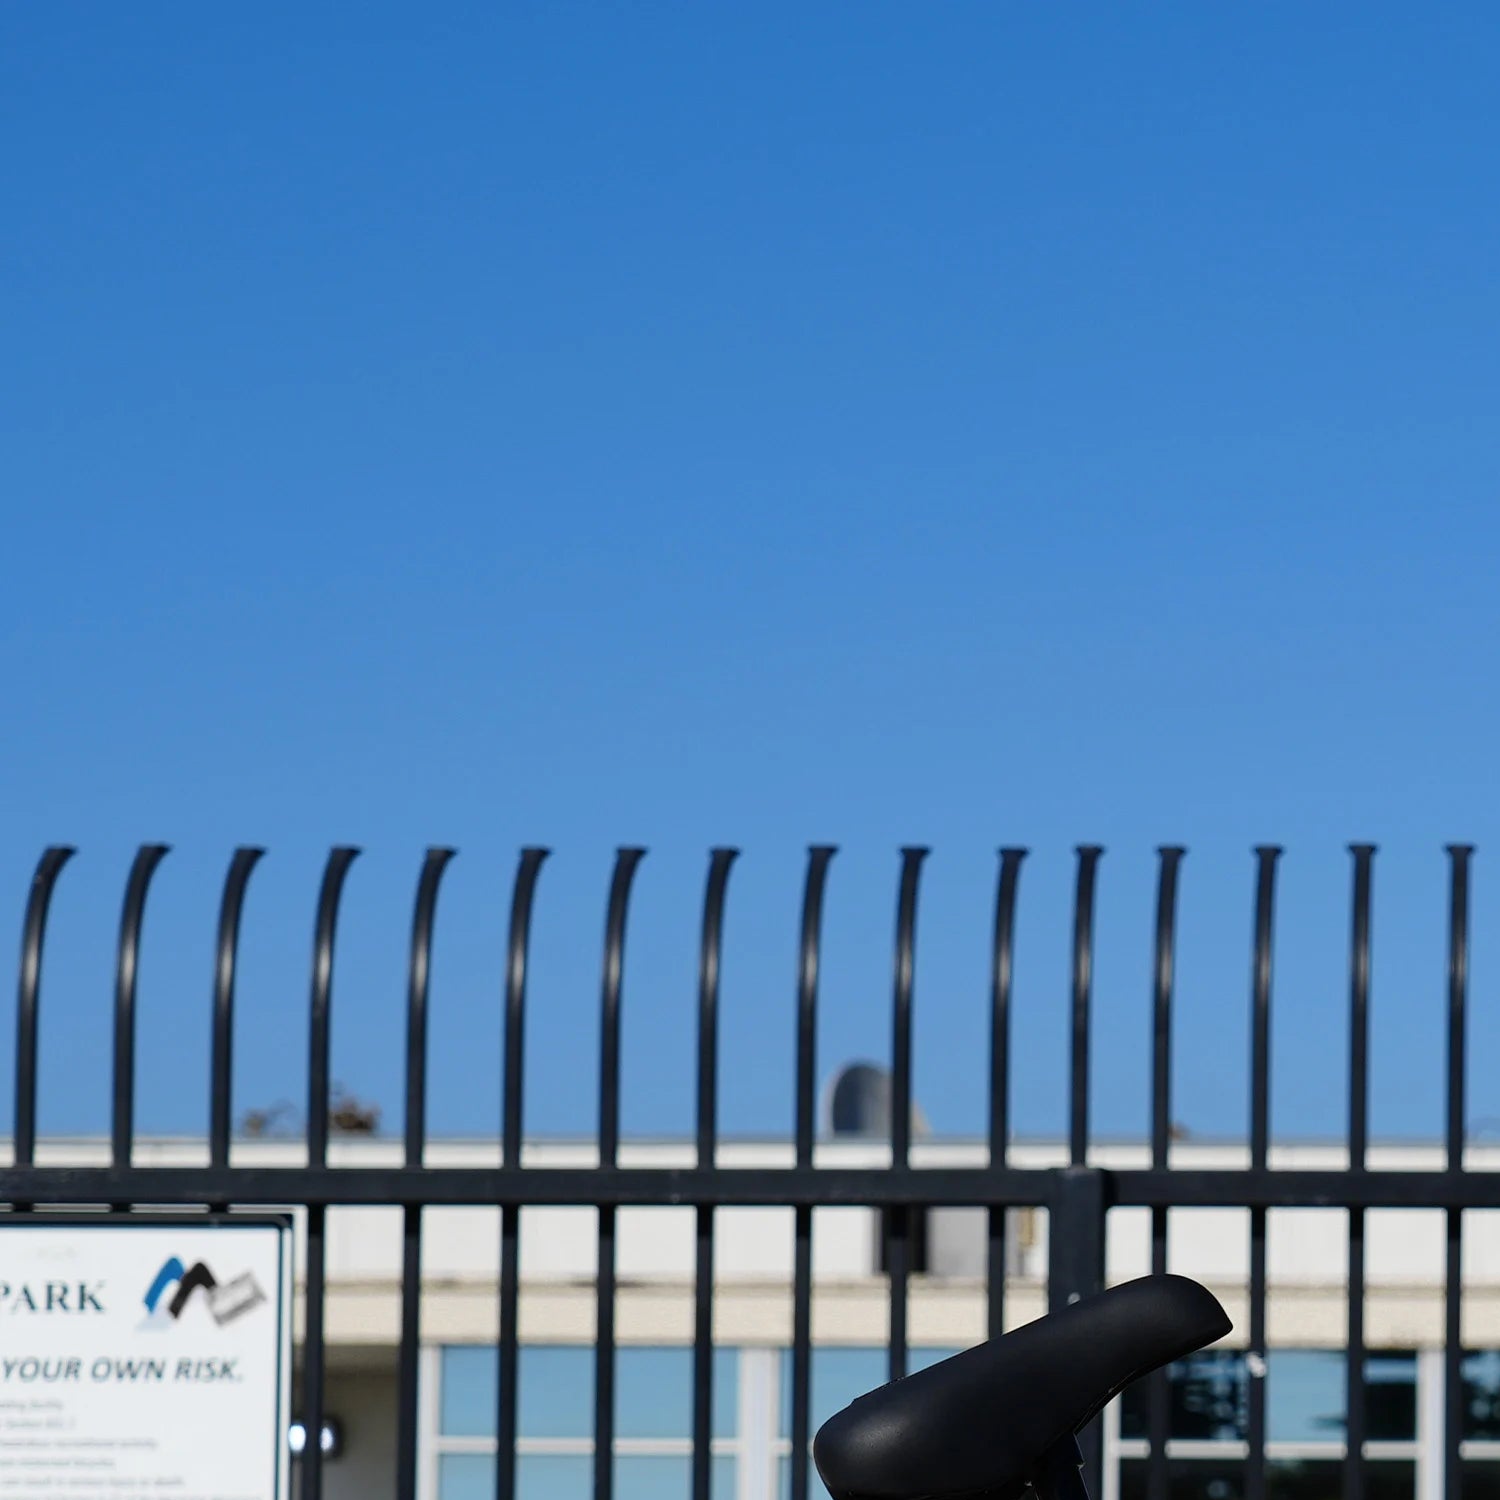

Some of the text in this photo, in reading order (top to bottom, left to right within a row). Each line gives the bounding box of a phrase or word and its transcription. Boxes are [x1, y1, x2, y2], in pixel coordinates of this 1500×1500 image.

[3, 1356, 244, 1382] YOUR OWN RISK.
